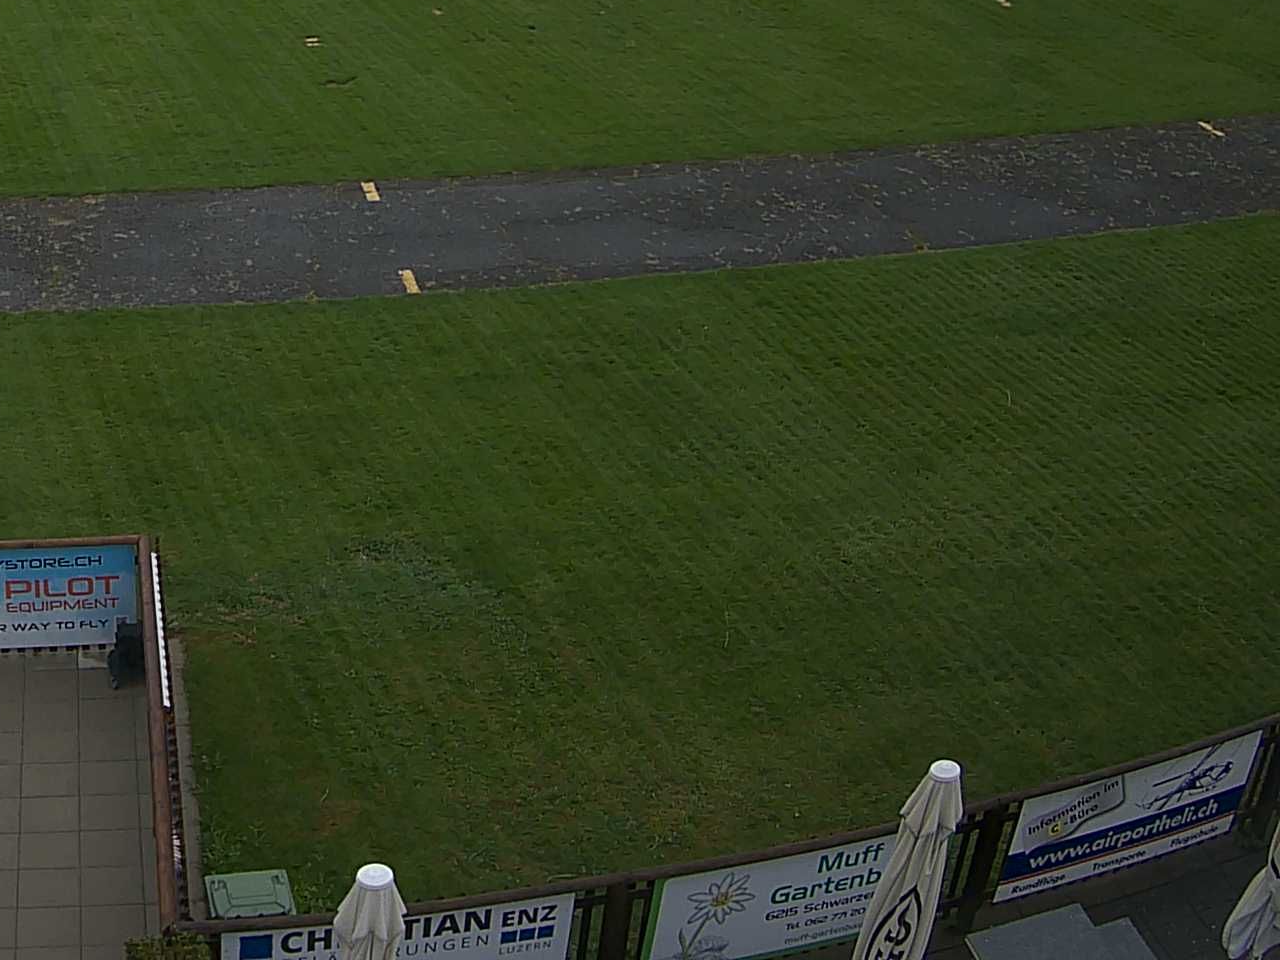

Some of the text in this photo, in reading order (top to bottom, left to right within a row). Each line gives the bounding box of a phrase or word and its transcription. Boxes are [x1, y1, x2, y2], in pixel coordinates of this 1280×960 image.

[4, 575, 120, 599] PILOT
[6, 597, 120, 613] EQUIPMENT
[11, 621, 49, 632] WAY
[55, 620, 76, 630] TO
[79, 618, 109, 630] FLY
[1028, 791, 1101, 835] Information
[1028, 798, 1219, 869] www.airportheli.ch
[817, 843, 885, 873] Muff
[770, 868, 882, 904] Gartenb
[765, 906, 800, 921] 6215
[281, 905, 558, 953] CHTIAN ENZ
[499, 941, 552, 955] LUZERN
